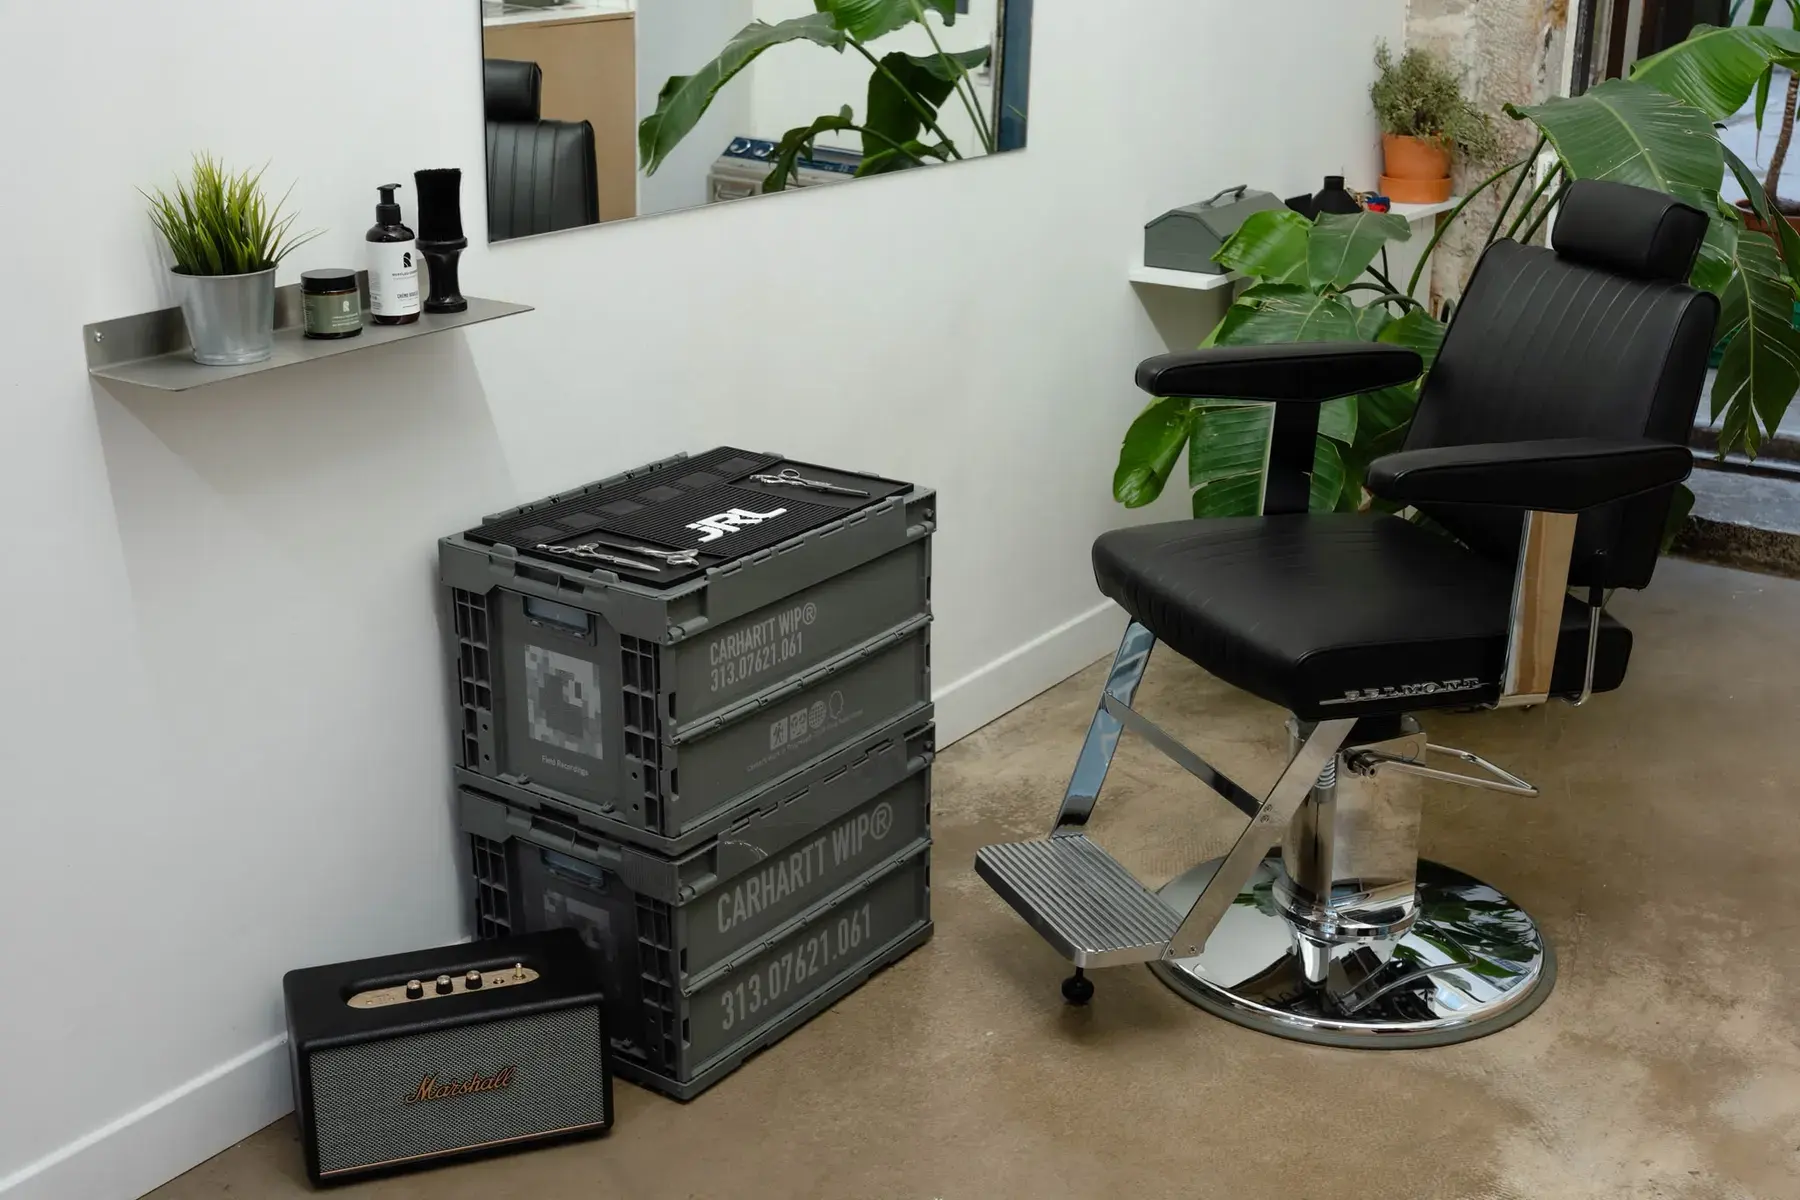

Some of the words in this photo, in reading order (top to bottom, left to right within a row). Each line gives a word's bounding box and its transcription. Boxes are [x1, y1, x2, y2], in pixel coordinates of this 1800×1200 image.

[685, 508, 787, 543] JRL
[710, 617, 775, 666] CARHARTT
[710, 631, 802, 692] 313.07621.061
[1344, 677, 1480, 702] BELMONT
[717, 837, 827, 933] CARHARTT
[721, 903, 871, 1030] 313.07621.061
[405, 1063, 518, 1103] Marshall
